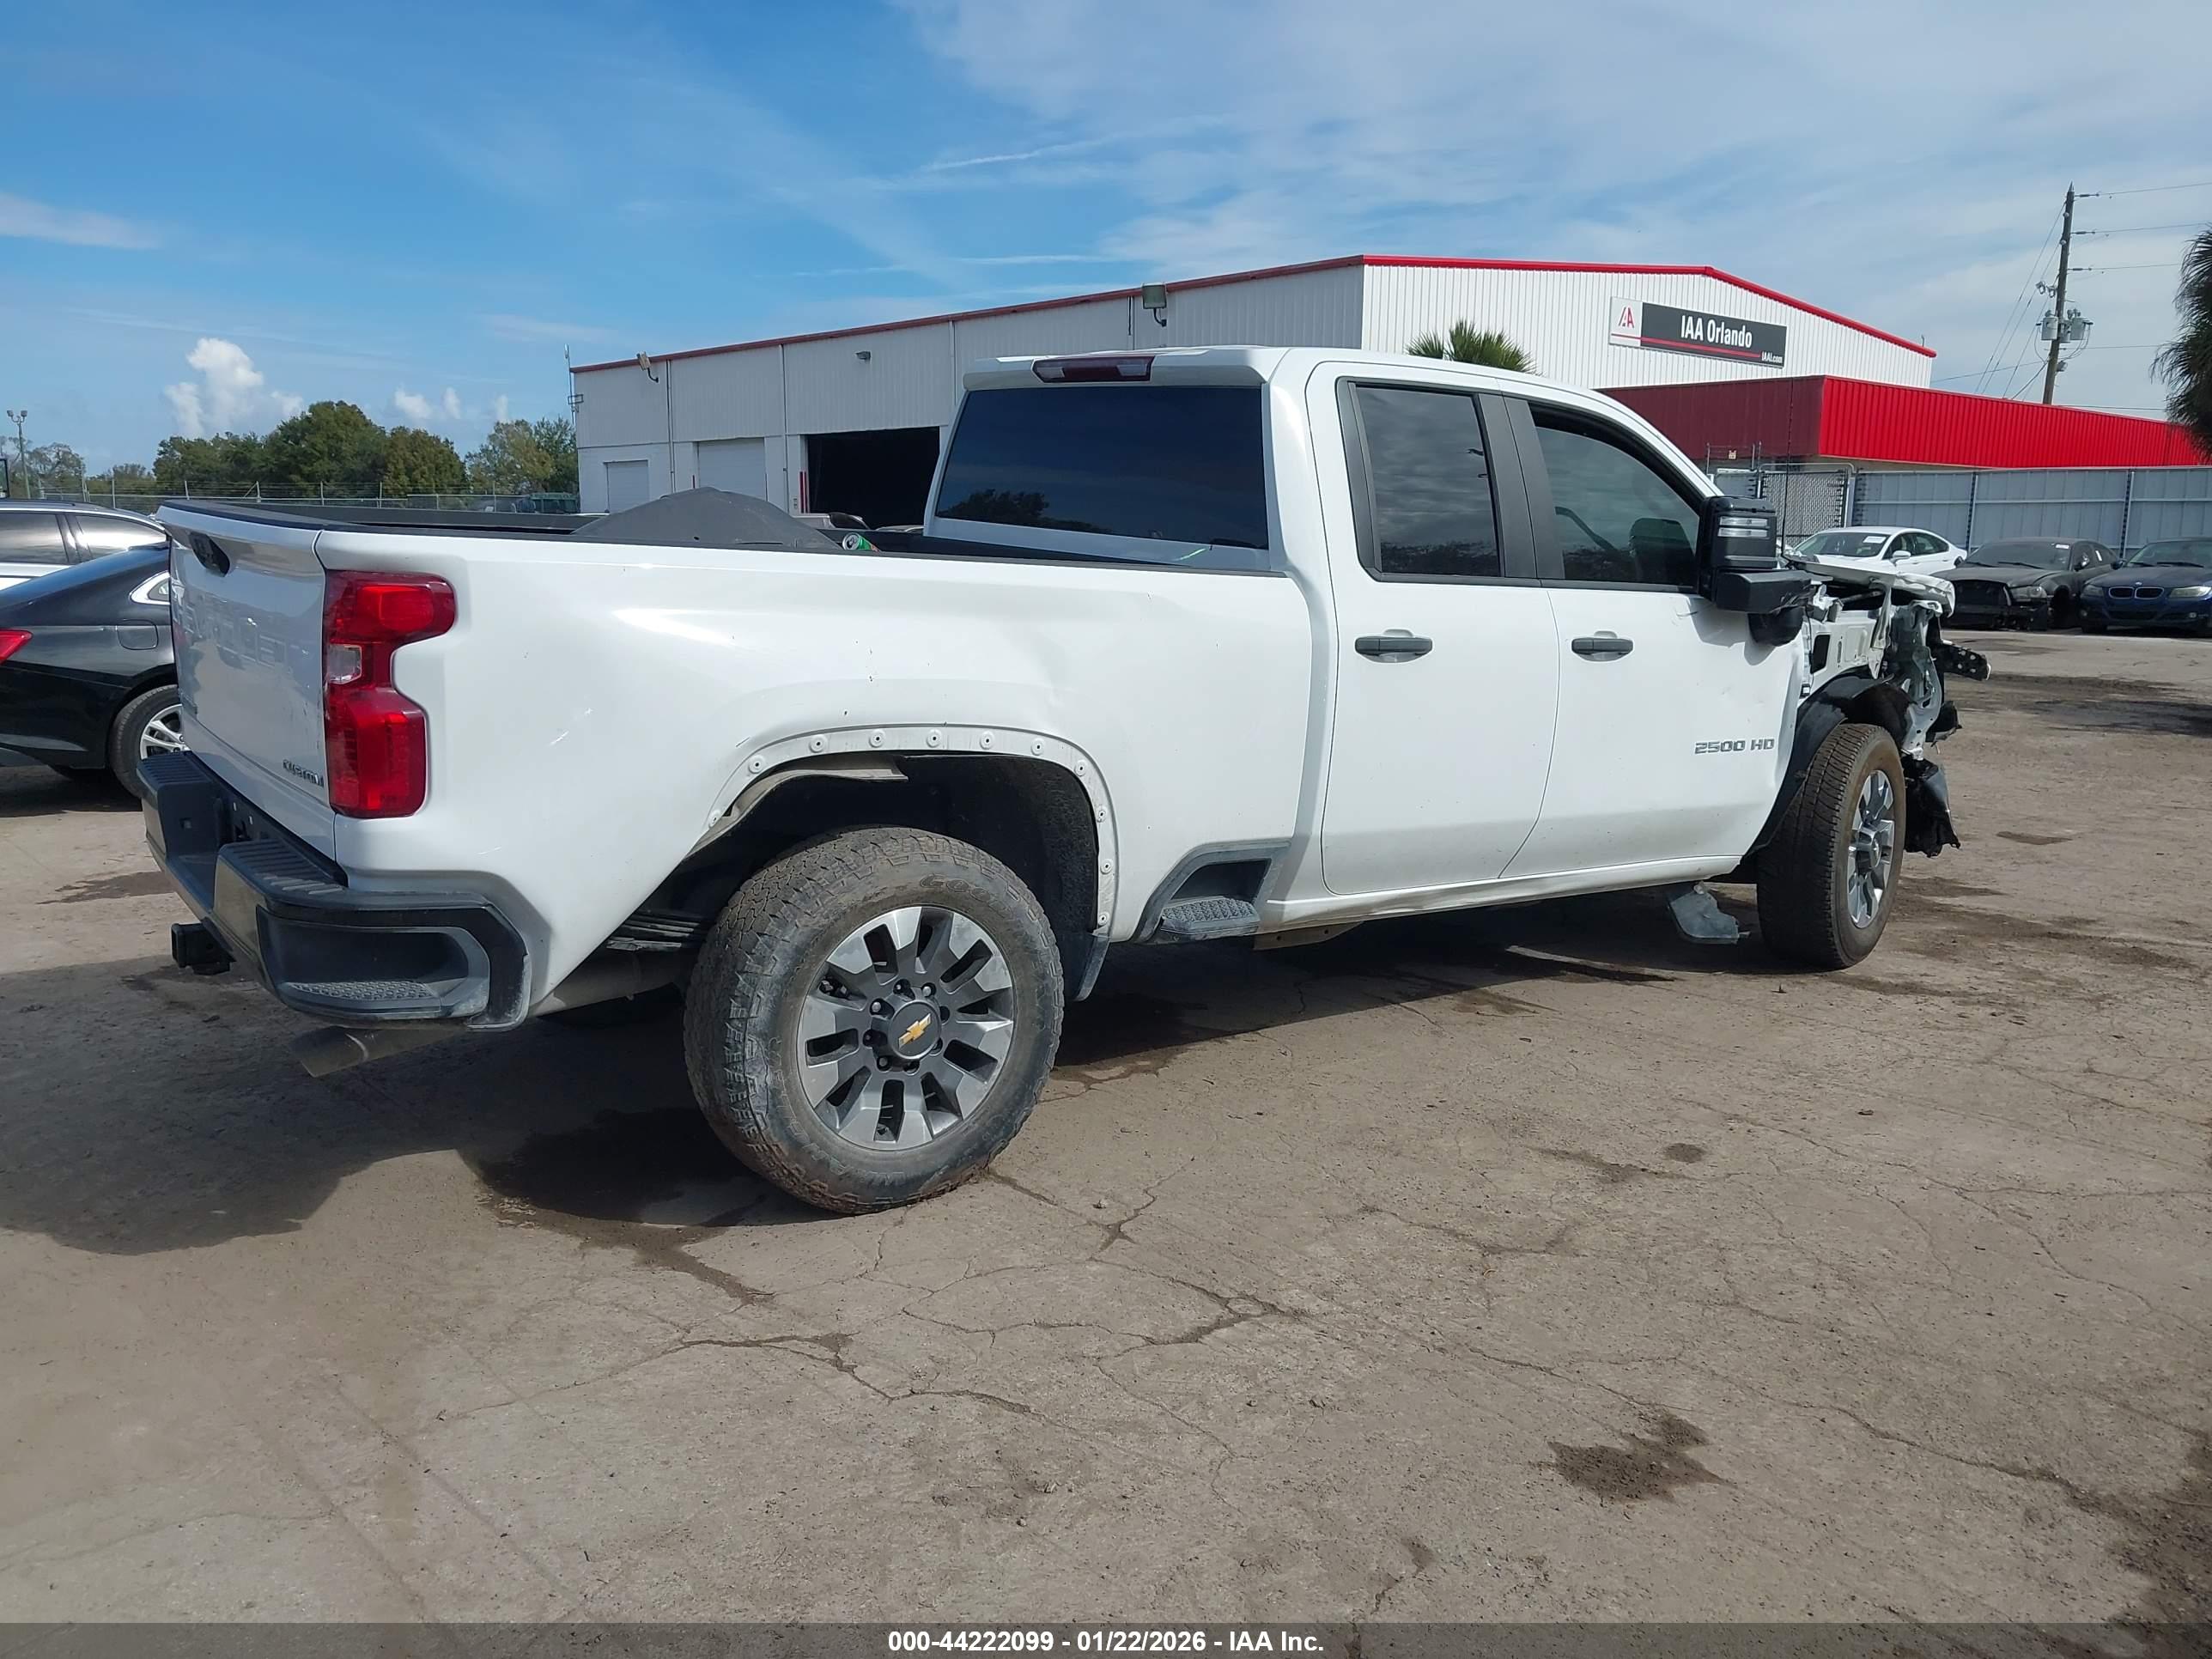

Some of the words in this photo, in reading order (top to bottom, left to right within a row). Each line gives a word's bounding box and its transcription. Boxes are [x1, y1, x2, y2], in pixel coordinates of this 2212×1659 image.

[1680, 315, 1704, 342] IAA
[1706, 319, 1753, 348] Orlando
[1694, 739, 1746, 754] 2500
[1750, 738, 1775, 750] HD
